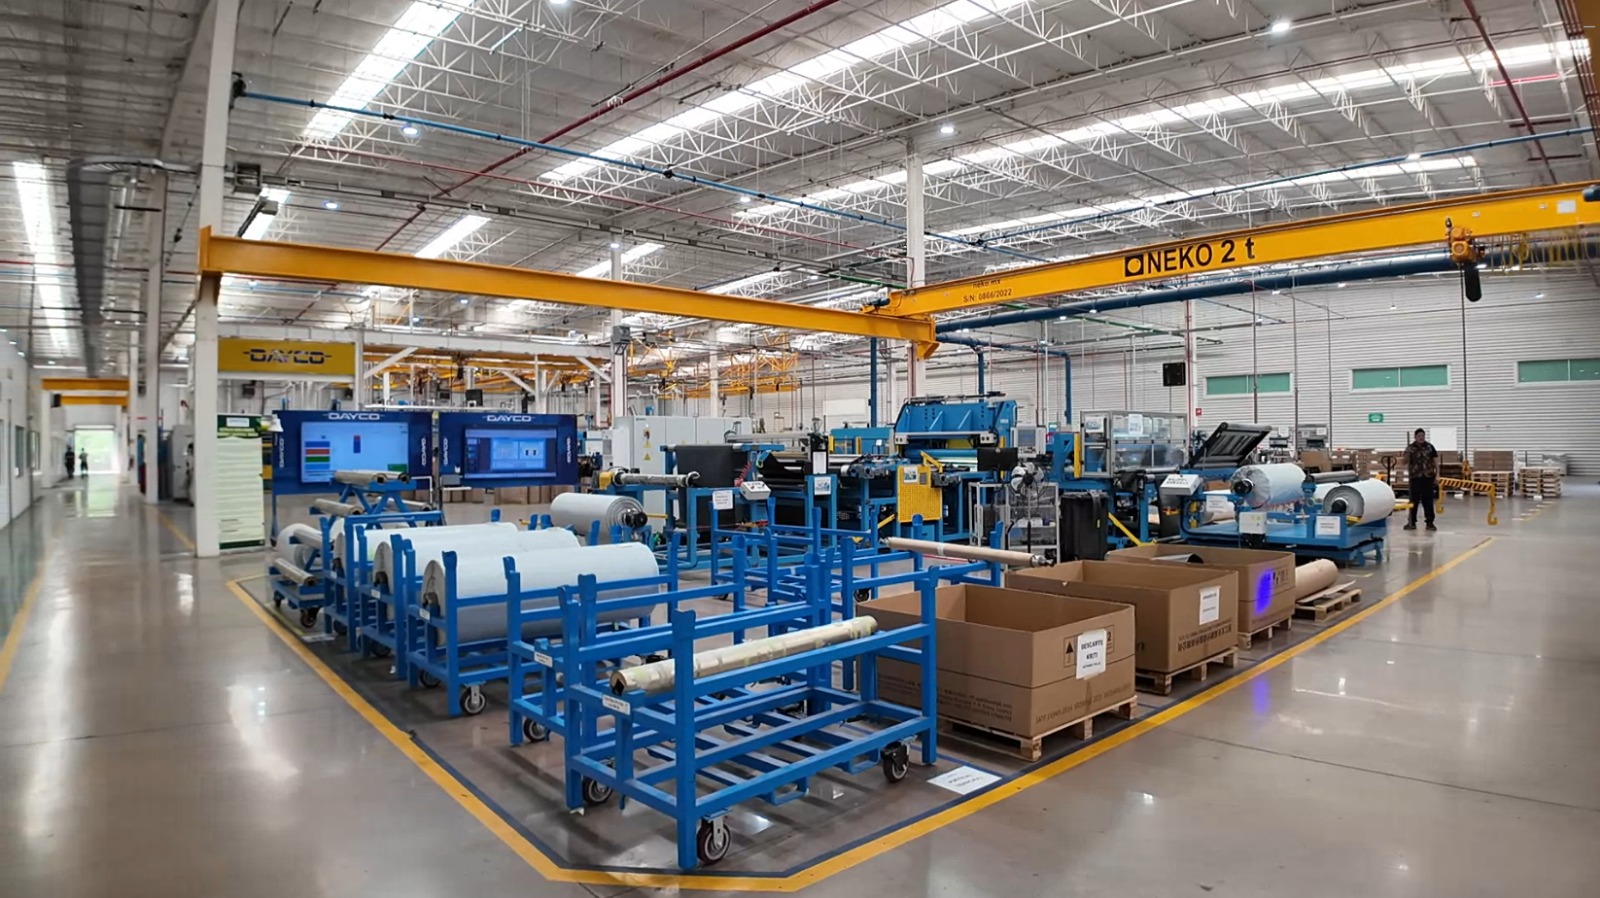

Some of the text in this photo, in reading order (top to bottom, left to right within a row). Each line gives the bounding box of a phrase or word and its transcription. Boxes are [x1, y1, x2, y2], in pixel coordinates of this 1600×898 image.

[1147, 236, 1256, 274] NEKO 2 t
[249, 348, 326, 364] DAYCO
[328, 412, 381, 420] DAYCO
[485, 414, 533, 422] DAYCO
